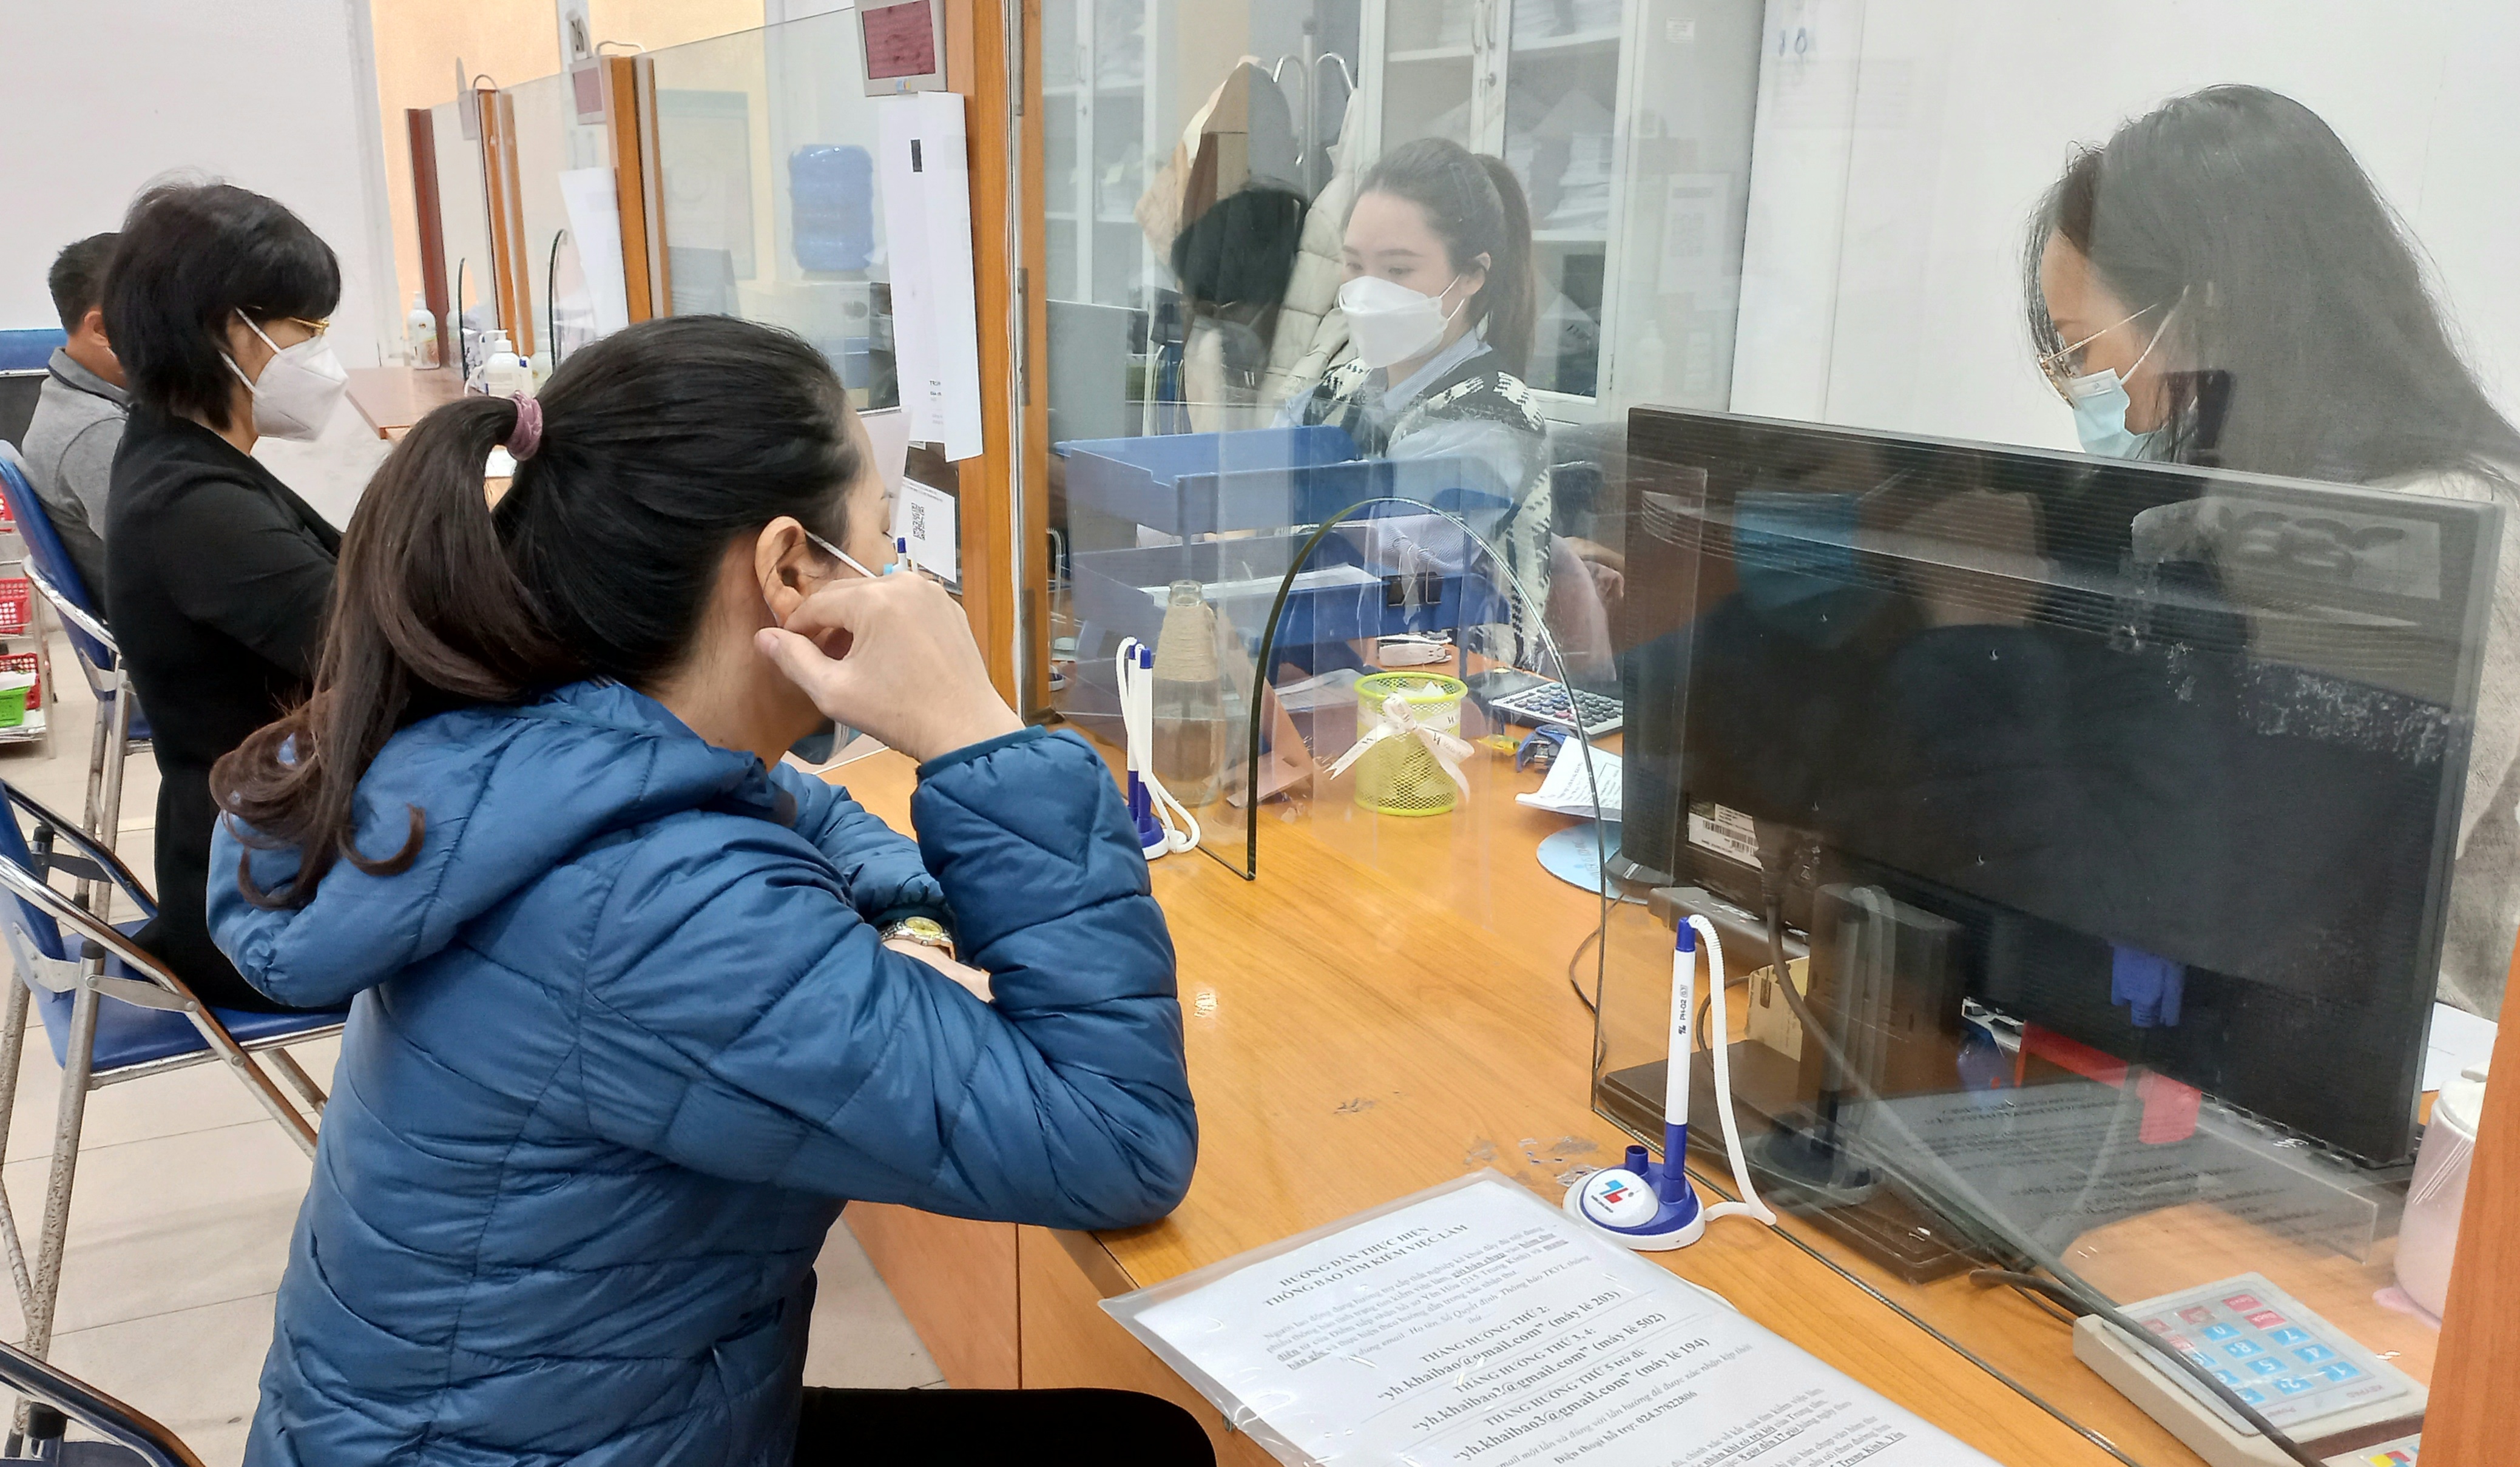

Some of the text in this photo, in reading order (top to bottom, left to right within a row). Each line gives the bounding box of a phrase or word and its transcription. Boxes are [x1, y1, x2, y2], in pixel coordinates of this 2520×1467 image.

[1264, 1224, 1468, 1306] THÔNG BÁO TÌM KIẾM VIỆC LÀM
[1279, 1227, 1430, 1287] HƯỚNG DẪN THỰC HIỆN
[1420, 1290, 1442, 1301] Yên
[1459, 1273, 1480, 1286] (215
[1357, 1343, 1382, 1356] dung
[1408, 1326, 1424, 1335] Họ
[1451, 1301, 1479, 1319] Quyết
[1498, 1281, 1529, 1296] Thông
[1525, 1274, 1544, 1284] báo
[1541, 1264, 1569, 1277] TKVL
[1547, 1309, 1582, 1327] (máy
[1590, 1290, 1621, 1306] 203)
[1377, 1320, 1399, 1331] theo
[1419, 1343, 1466, 1363] THÁNG
[1508, 1309, 1538, 1326] THỨ
[1536, 1306, 1550, 1314] 2:
[1591, 1332, 1627, 1351] (máy
[1635, 1312, 1666, 1329] 502)
[2283, 1330, 2300, 1341] 7
[1451, 1371, 1500, 1393] THÁNG
[1542, 1337, 1573, 1354] THỨ
[1570, 1334, 1587, 1342] 3,
[1634, 1358, 1670, 1377] (máy
[1678, 1337, 1711, 1354] 194)
[2235, 1342, 2252, 1353] 8
[2304, 1347, 2320, 1358] 4
[2258, 1360, 2275, 1371] 5
[2331, 1366, 2346, 1376] 1
[1482, 1403, 1532, 1426] THÁNG
[1575, 1366, 1606, 1384] THỨ
[1603, 1363, 1615, 1372] 5
[1630, 1348, 1647, 1359] đi:
[2281, 1378, 2300, 1388] 2
[2346, 1384, 2385, 1398] KEYPAD
[1496, 1454, 1521, 1467] mail
[1538, 1440, 1556, 1451] lần
[1555, 1434, 1569, 1444] và
[1591, 1415, 1608, 1427] với
[1605, 1408, 1624, 1420] lần
[1662, 1377, 1685, 1391] được
[1683, 1369, 1701, 1380] xác
[1700, 1358, 1723, 1372] nhận
[1553, 1451, 1580, 1465] Điện
[1577, 1437, 1606, 1453] thoại
[1616, 1422, 1639, 1435] trợ:
[1635, 1391, 1698, 1424] 024.37822806
[1684, 1446, 1709, 1461] chính
[1720, 1431, 1734, 1441] về
[1721, 1443, 1743, 1457] khi
[1738, 1437, 1754, 1449] có
[1748, 1431, 1766, 1443] trả
[1737, 1453, 1751, 1462] 8
[1745, 1446, 1764, 1459] giờ
[1758, 1438, 1779, 1452] đến
[1773, 1432, 1790, 1444] 17
[1784, 1423, 1804, 1438] giờ
[1814, 1437, 1836, 1451] chụp
[1822, 1450, 1839, 1462] có)
[1834, 1442, 1854, 1454] theo
[1835, 1451, 1870, 1467] Trung
[1884, 1431, 1907, 1445] Yên
